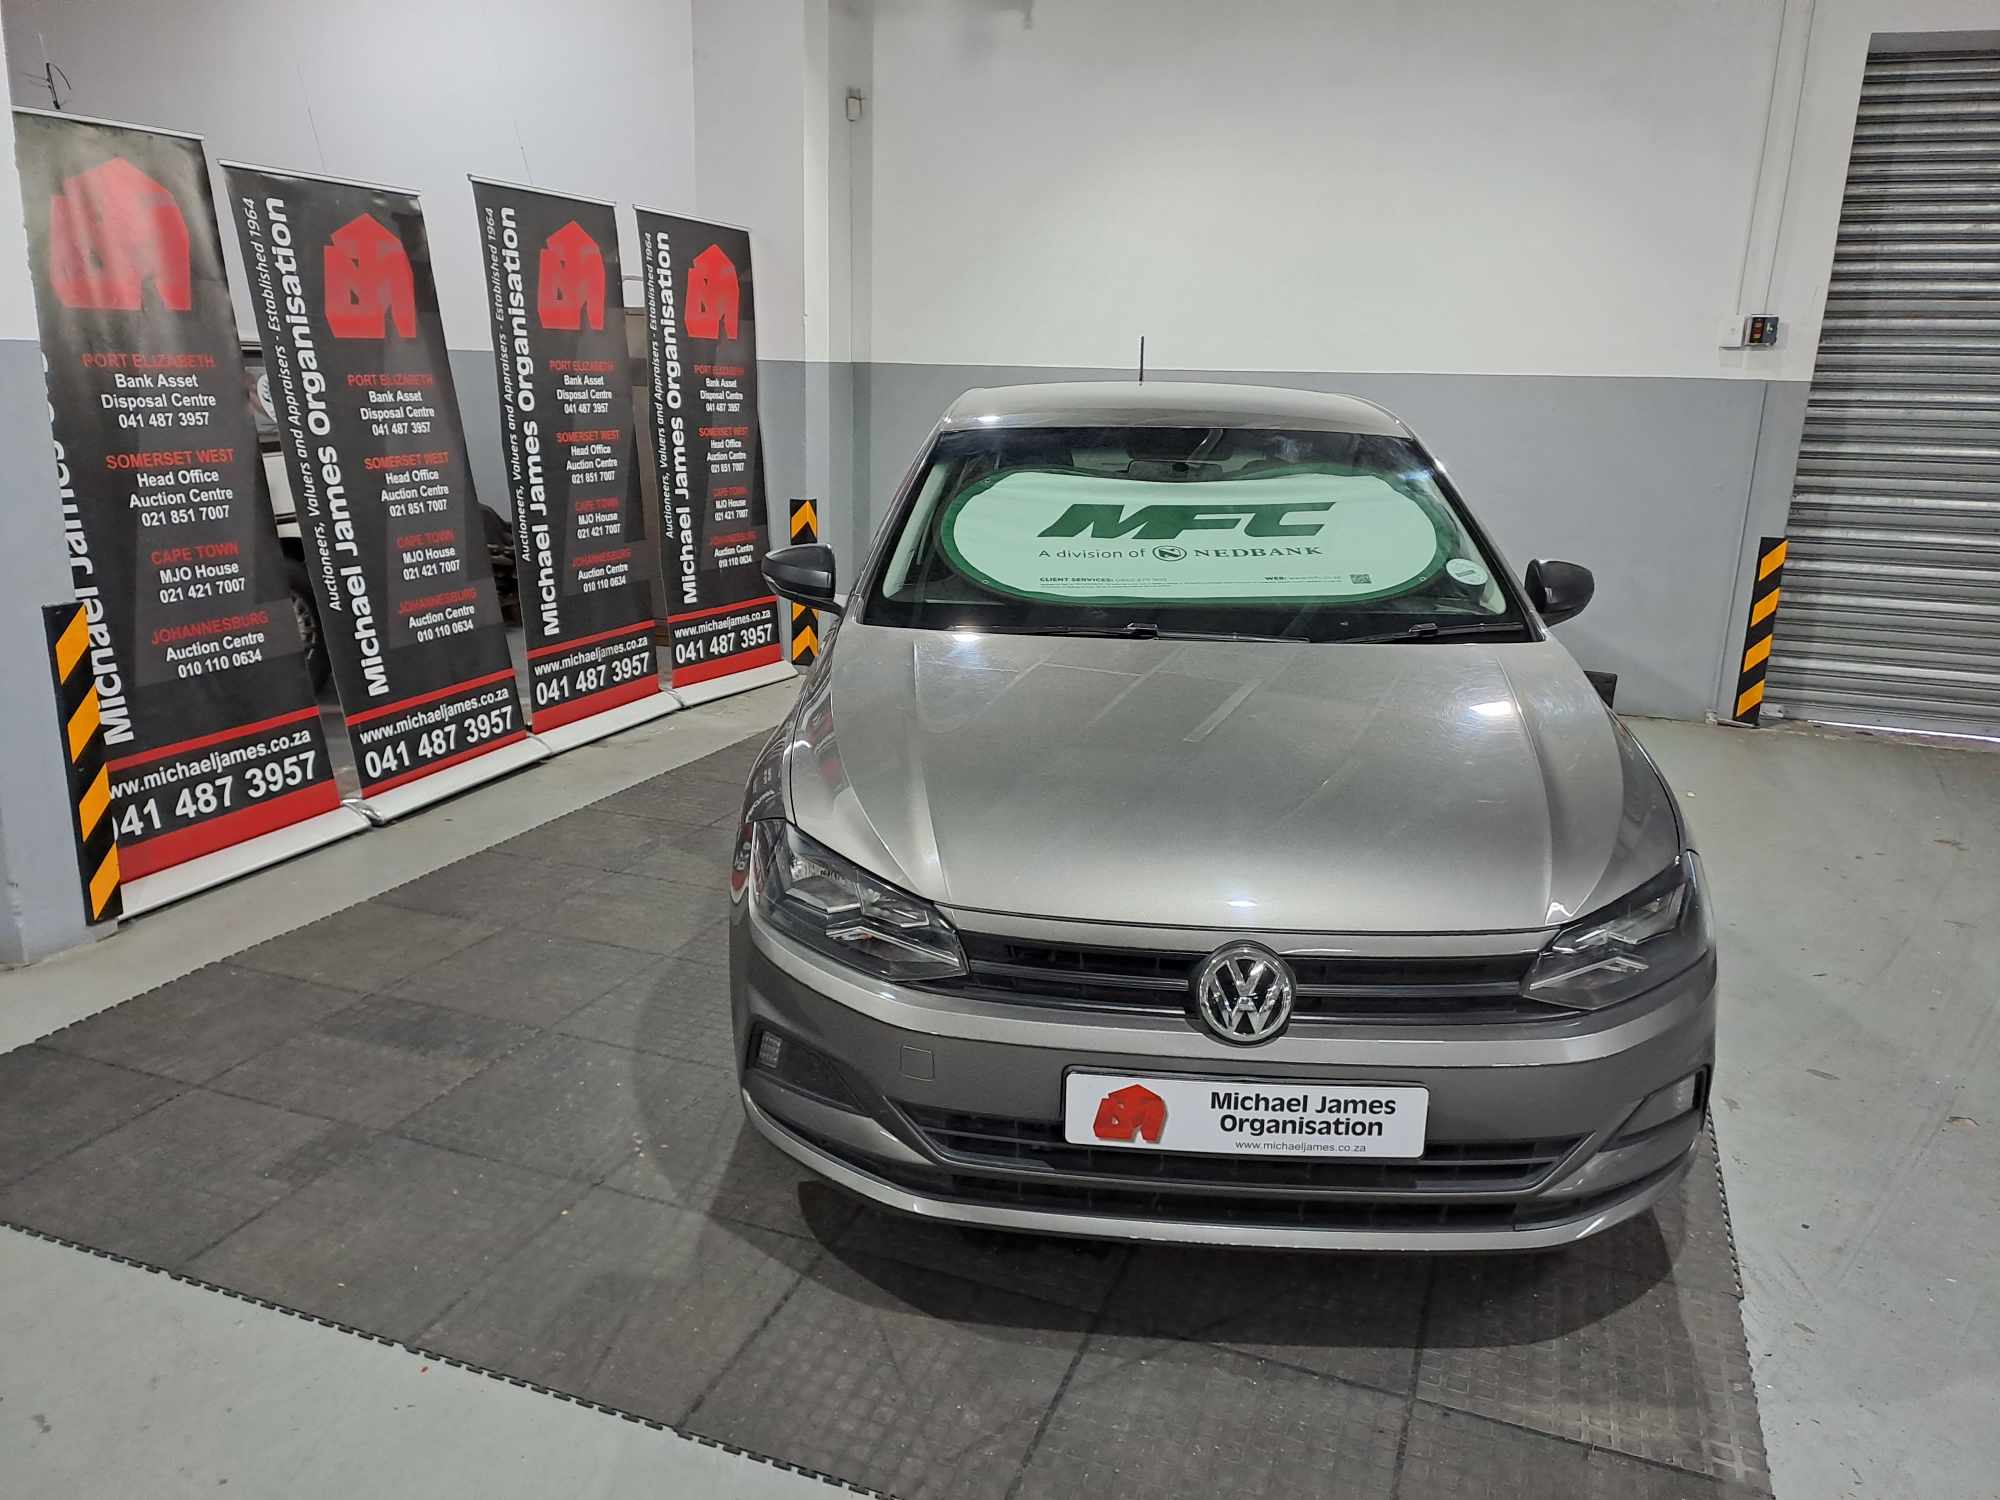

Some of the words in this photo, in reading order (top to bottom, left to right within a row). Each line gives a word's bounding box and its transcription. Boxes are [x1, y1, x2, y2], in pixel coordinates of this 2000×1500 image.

[242, 197, 263, 238] 1964
[485, 207, 496, 241] 1964
[255, 242, 281, 332] Established
[266, 198, 330, 436] Organisation
[501, 207, 535, 412] Organisation
[656, 231, 682, 409] Organisation
[82, 353, 128, 368] PORT
[114, 373, 154, 388] Bank
[157, 374, 199, 388] Asset
[274, 343, 302, 425] Appraisers
[563, 375, 582, 385] Bank
[100, 394, 167, 411] Disposal
[171, 393, 216, 407] Centre
[368, 390, 395, 403] Bank
[396, 390, 423, 402] Asset
[556, 389, 588, 401] Disposal
[118, 414, 145, 429] 041
[148, 413, 173, 427] 487
[179, 412, 209, 427] 3957
[360, 407, 403, 421] Disposal
[406, 406, 435, 418] Centre
[505, 405, 516, 430] and
[564, 403, 577, 414] 041
[655, 402, 665, 425] and
[372, 423, 389, 436] 041
[391, 423, 408, 434] 487
[411, 422, 431, 433] 3957
[290, 427, 308, 458] and
[657, 428, 668, 468] Valuers
[106, 451, 192, 470] SOMERSET
[196, 449, 234, 463] WEST
[510, 434, 522, 481] Valuers
[523, 420, 547, 516] James
[566, 460, 594, 471] Auction
[671, 416, 689, 500] James
[137, 471, 174, 488] Head
[178, 469, 219, 484] Office
[385, 471, 409, 484] Head
[411, 469, 439, 481] Office
[129, 490, 186, 509] Auction
[189, 487, 233, 503] Centre
[300, 462, 321, 517] Valuers
[317, 446, 359, 557] James
[381, 488, 418, 502] Auction
[420, 485, 449, 497] Centre
[141, 511, 167, 527] 021
[170, 509, 196, 524] 851
[199, 505, 230, 521] 7007
[389, 504, 406, 517] 021
[408, 502, 425, 515] 851
[427, 499, 448, 512] 7007
[1037, 501, 1337, 540] MFC
[151, 547, 192, 565] CAPE
[196, 542, 240, 558] TOWN
[402, 549, 423, 564] MJO
[425, 546, 455, 560] House
[676, 506, 698, 605] Michael
[1038, 549, 1050, 559] A
[1056, 548, 1124, 560] division
[1128, 548, 1146, 559] of
[1193, 546, 1324, 558] NEDBANK
[159, 567, 191, 584] MJO
[195, 563, 239, 578] House
[314, 522, 342, 611] Auctioneers,
[403, 567, 419, 580] 021
[421, 563, 438, 576] 421
[439, 559, 460, 573] 7007
[159, 588, 184, 604] 021
[188, 583, 212, 599] 421
[216, 577, 246, 595] 7007
[531, 523, 560, 637] Michael
[151, 610, 269, 645] JOHANNESBURG
[409, 611, 444, 628] Auction
[445, 605, 475, 620] Centre
[340, 566, 390, 697] Michael
[417, 628, 433, 642] 010
[435, 623, 450, 638] 110
[452, 619, 474, 634] 0634
[166, 641, 219, 662] Auction
[223, 632, 264, 649] Centre
[534, 636, 648, 676] www.michaeljames.co.za
[675, 639, 704, 664] 041
[710, 632, 735, 655] 487
[740, 623, 772, 648] 3957
[178, 662, 202, 678] 010
[205, 656, 229, 673] 110
[232, 649, 262, 666] 0634
[536, 675, 569, 705] 041
[575, 664, 607, 692] 487
[611, 652, 650, 682] 3957
[359, 687, 509, 745] www.michaeljames.co.za
[365, 740, 410, 778] 041
[418, 724, 457, 760] 487
[464, 705, 513, 743] 3957
[175, 775, 233, 818] 487
[245, 749, 316, 798] 3957
[1210, 1091, 1308, 1114] Michael
[1315, 1095, 1396, 1115] James
[1219, 1113, 1383, 1137] Organisation
[1234, 1139, 1366, 1153] www.michaeljames.co.za
